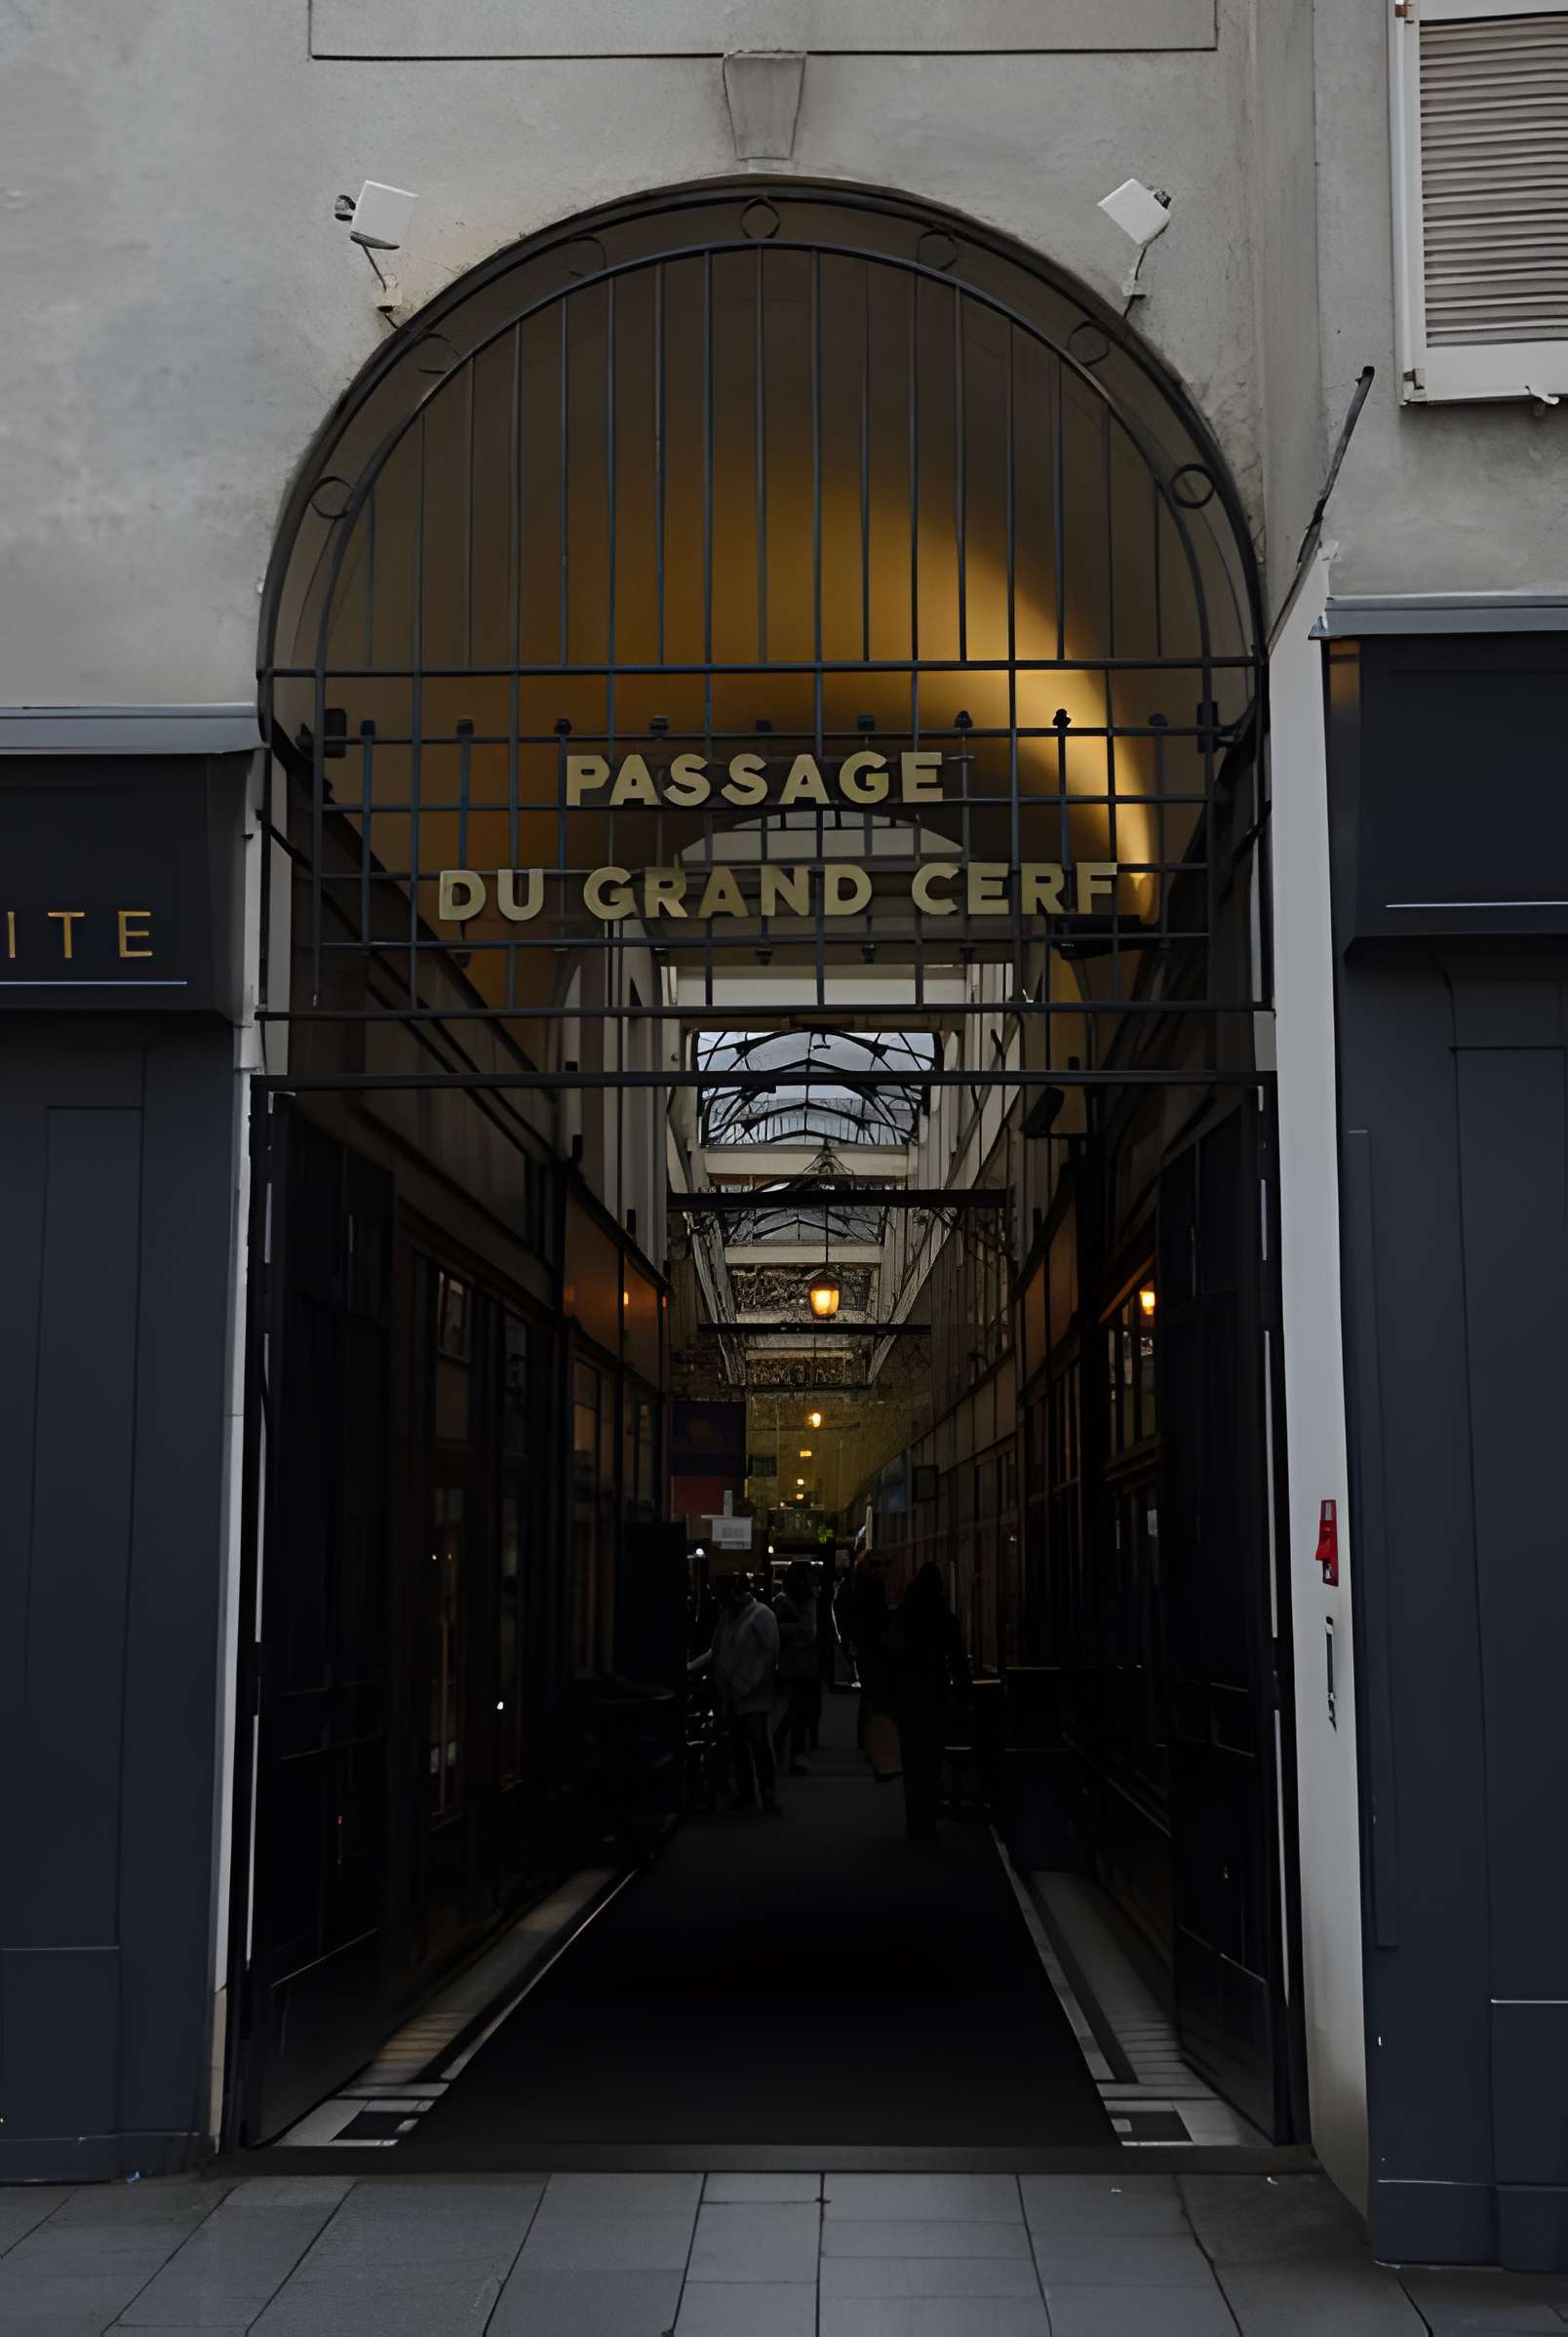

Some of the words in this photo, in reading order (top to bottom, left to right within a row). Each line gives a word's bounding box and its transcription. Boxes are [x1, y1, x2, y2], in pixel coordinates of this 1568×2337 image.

[566, 752, 944, 808] PASSAGE
[439, 868, 545, 922] DU
[582, 864, 874, 921] GRAND
[911, 862, 1118, 916] CERF
[7, 910, 153, 959] ITE
